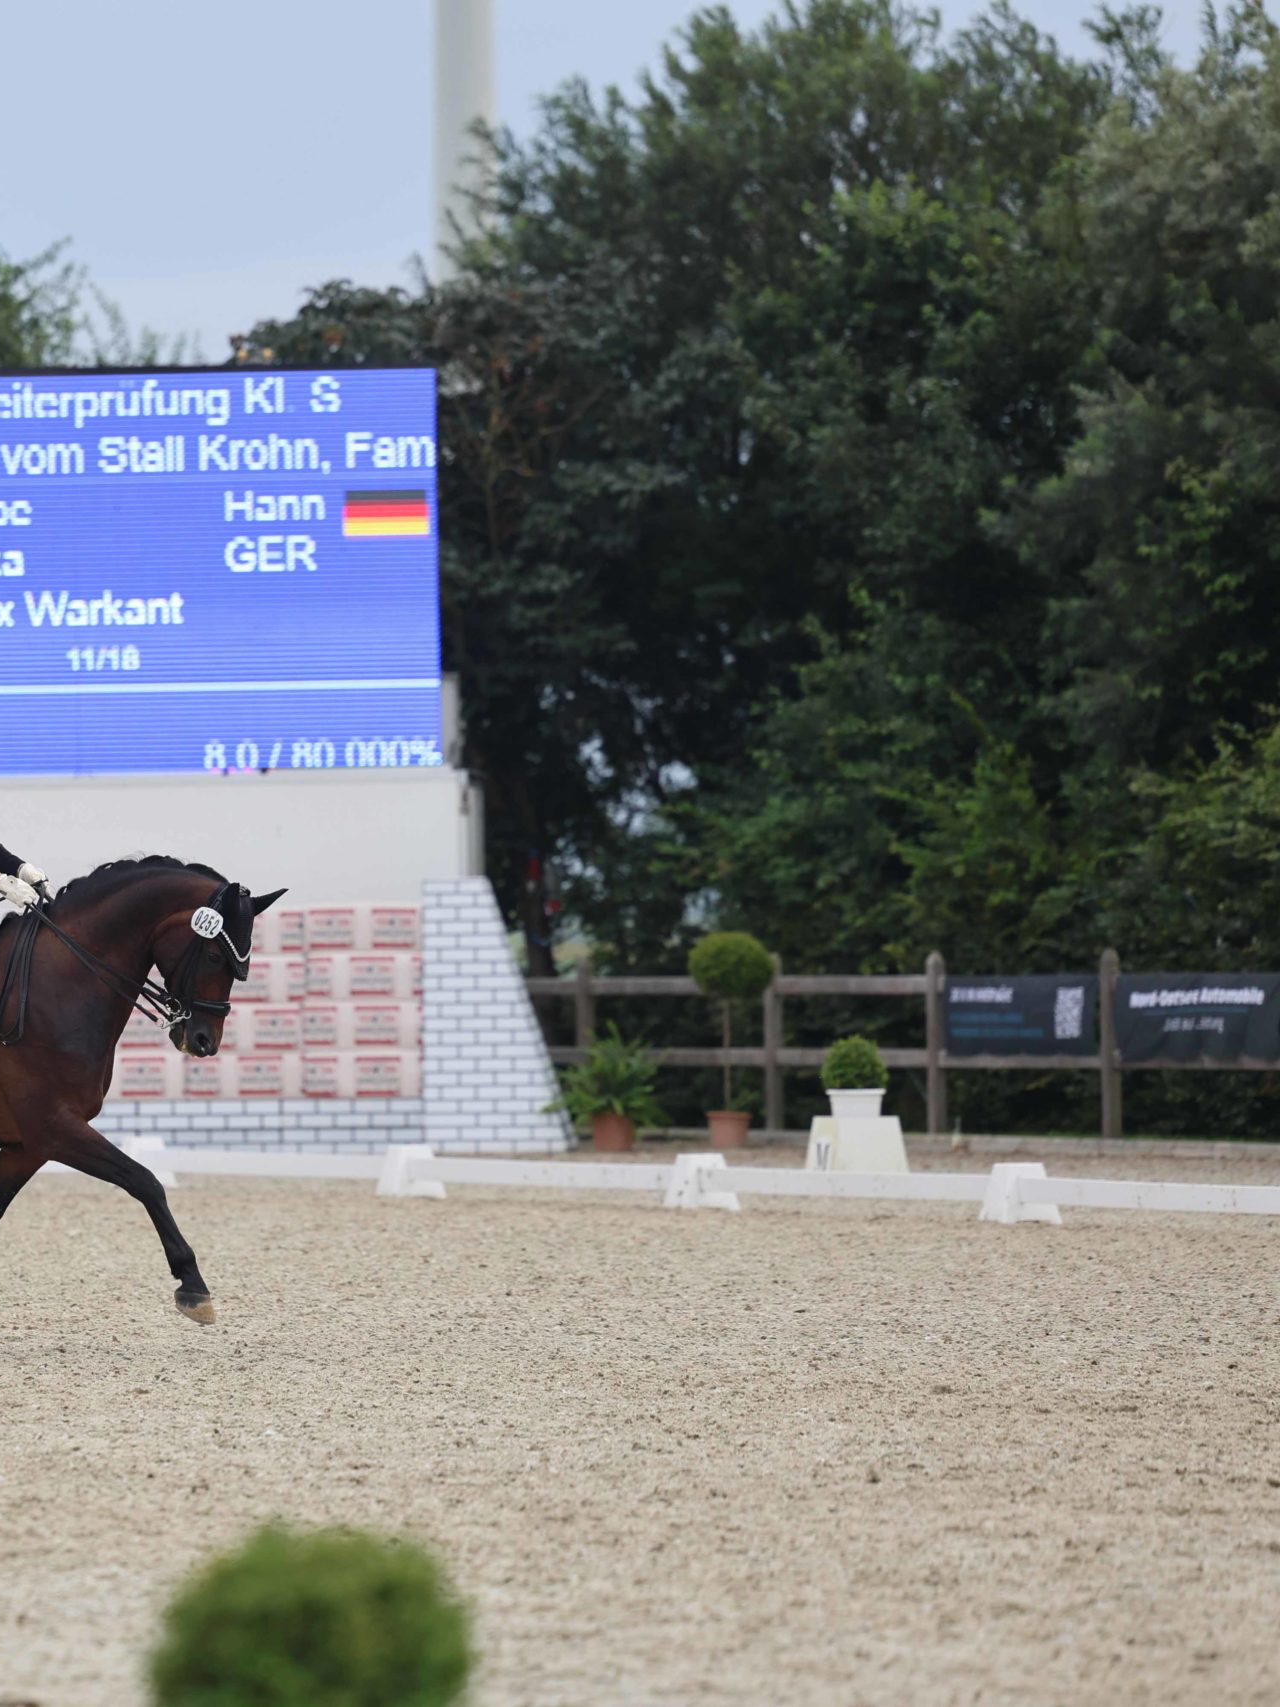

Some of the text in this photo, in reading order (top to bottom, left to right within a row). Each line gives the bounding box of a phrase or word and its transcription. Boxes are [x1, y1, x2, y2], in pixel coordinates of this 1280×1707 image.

[310, 375, 341, 413] S
[0, 443, 84, 475] vom
[98, 435, 185, 473] Stall
[199, 433, 331, 475] Krohn,
[225, 490, 325, 522] Hann
[224, 534, 317, 573] GER
[24, 590, 184, 627] Warkant
[66, 644, 141, 671] 11/18
[194, 911, 220, 936] 0252
